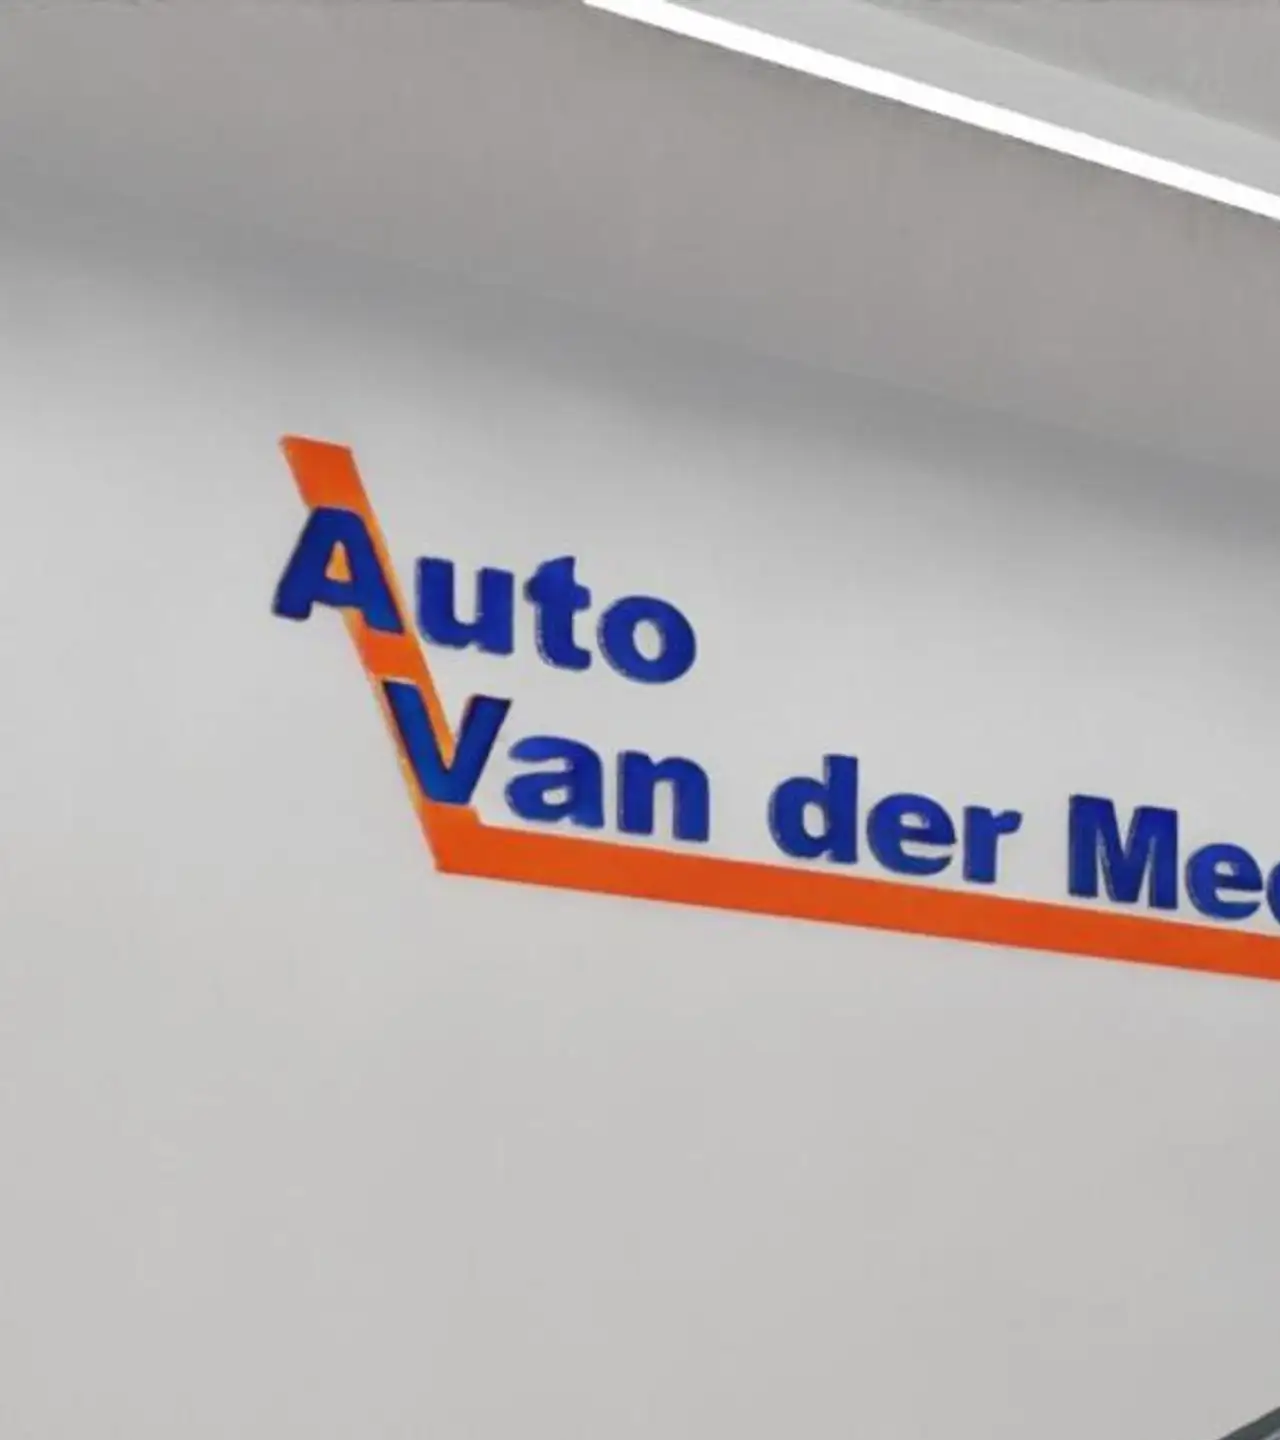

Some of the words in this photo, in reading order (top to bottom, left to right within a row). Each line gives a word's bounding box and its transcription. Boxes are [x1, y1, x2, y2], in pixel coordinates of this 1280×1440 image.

[272, 506, 696, 684] Auto
[382, 680, 710, 842] Van
[768, 754, 1022, 883] der
